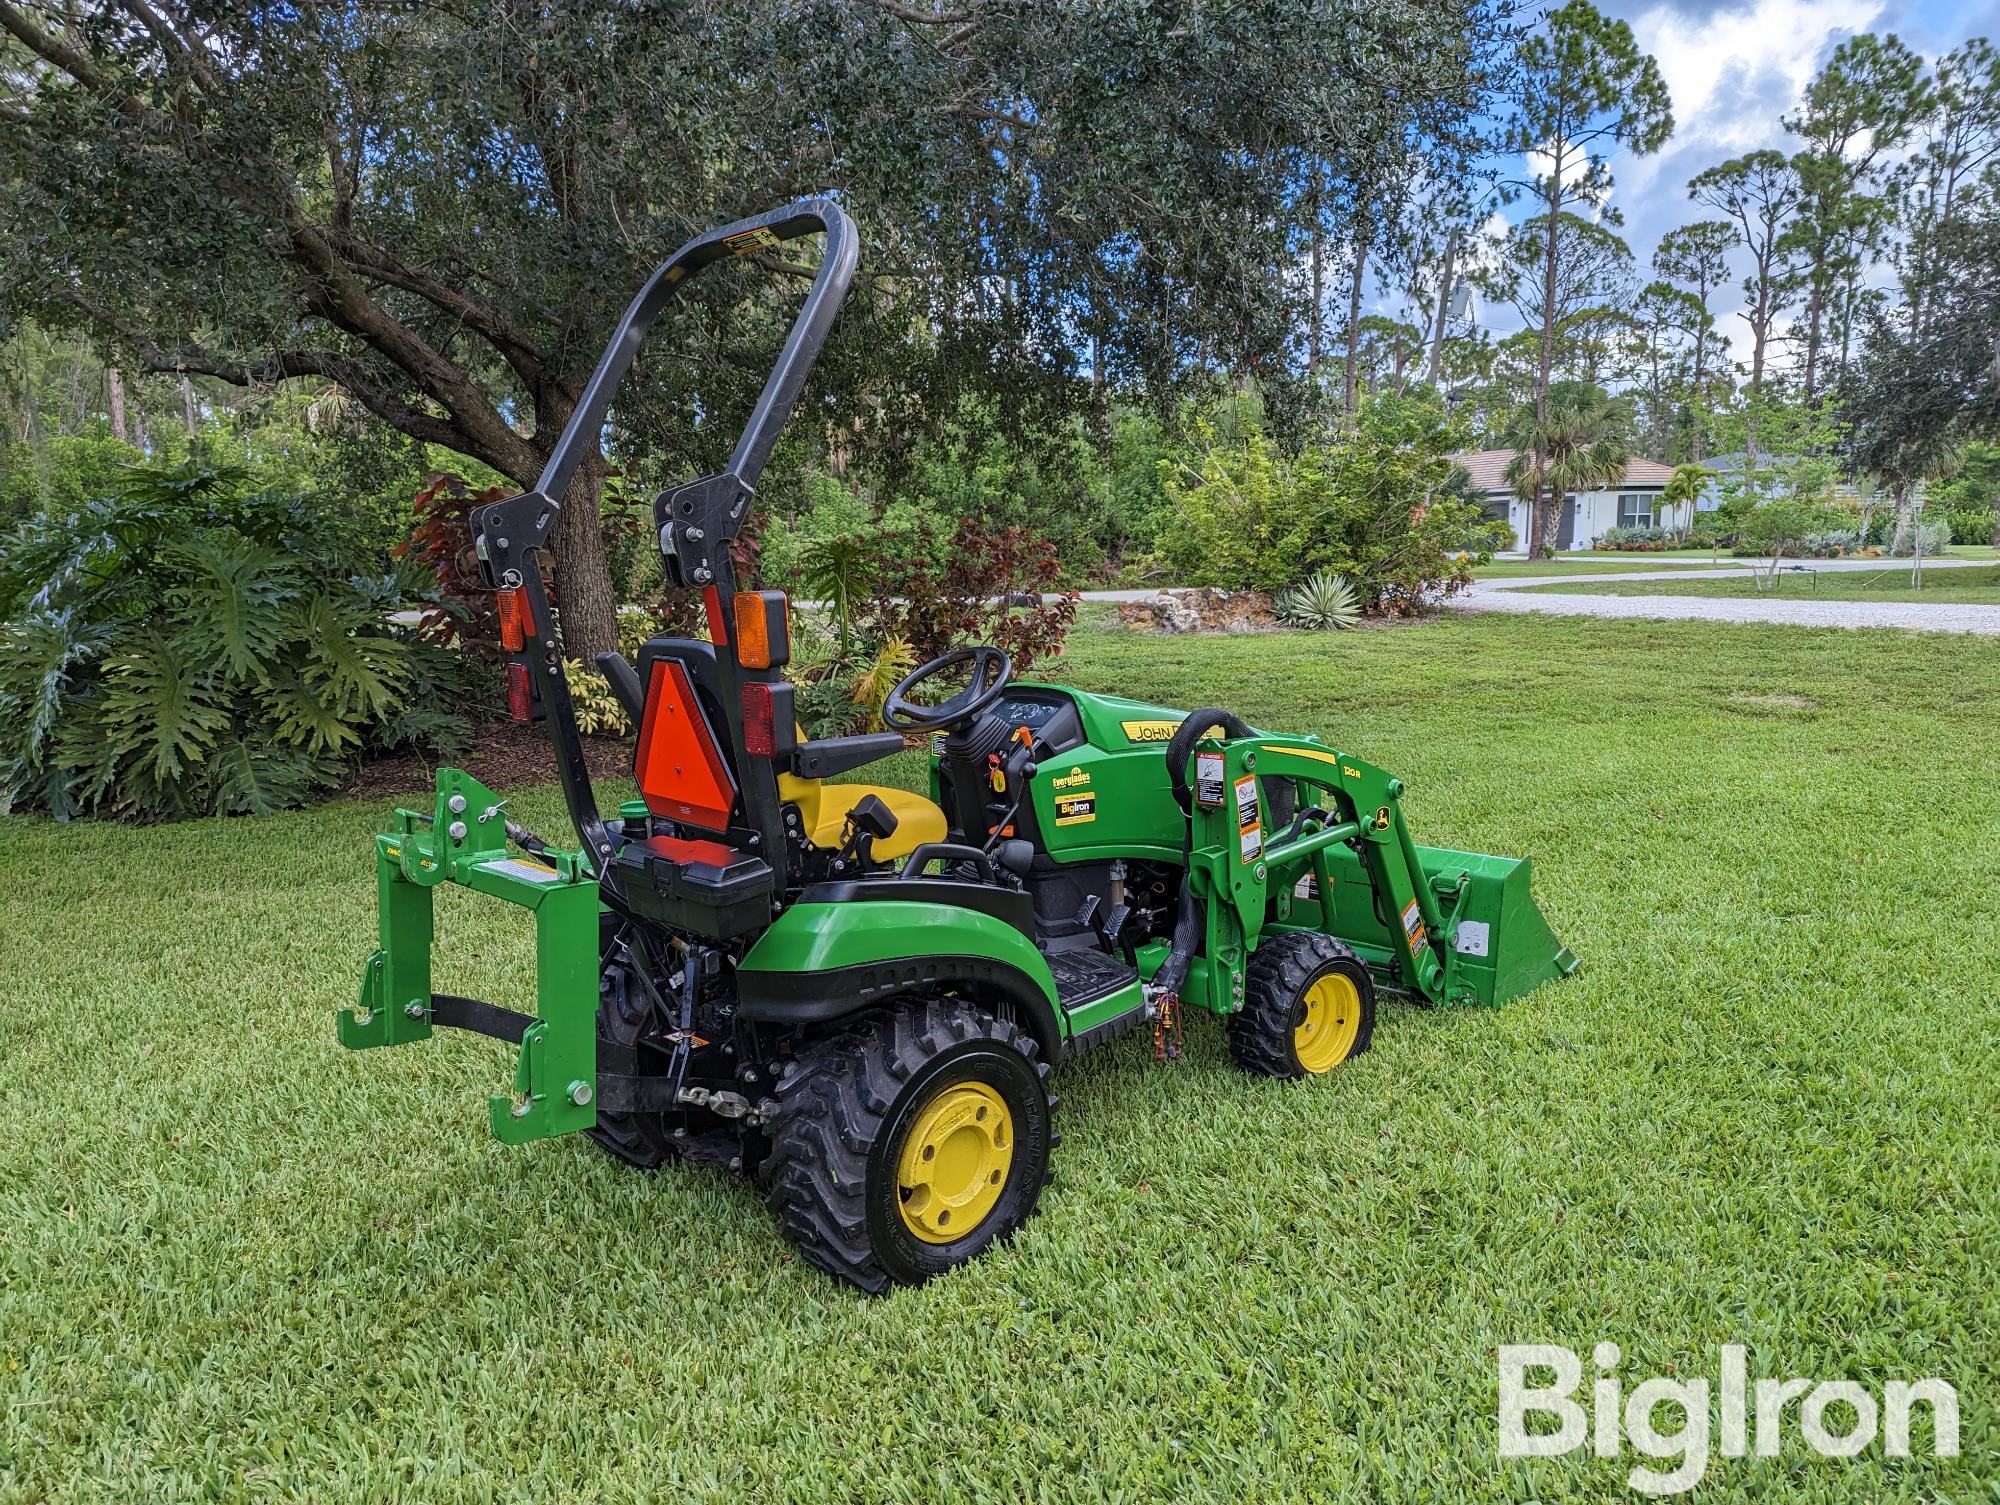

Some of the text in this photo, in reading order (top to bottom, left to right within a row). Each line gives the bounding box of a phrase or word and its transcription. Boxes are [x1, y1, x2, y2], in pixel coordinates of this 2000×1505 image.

[1137, 726, 1170, 739] JOHN
[1052, 772, 1091, 787] Everglades
[1061, 801, 1090, 815] BigIron
